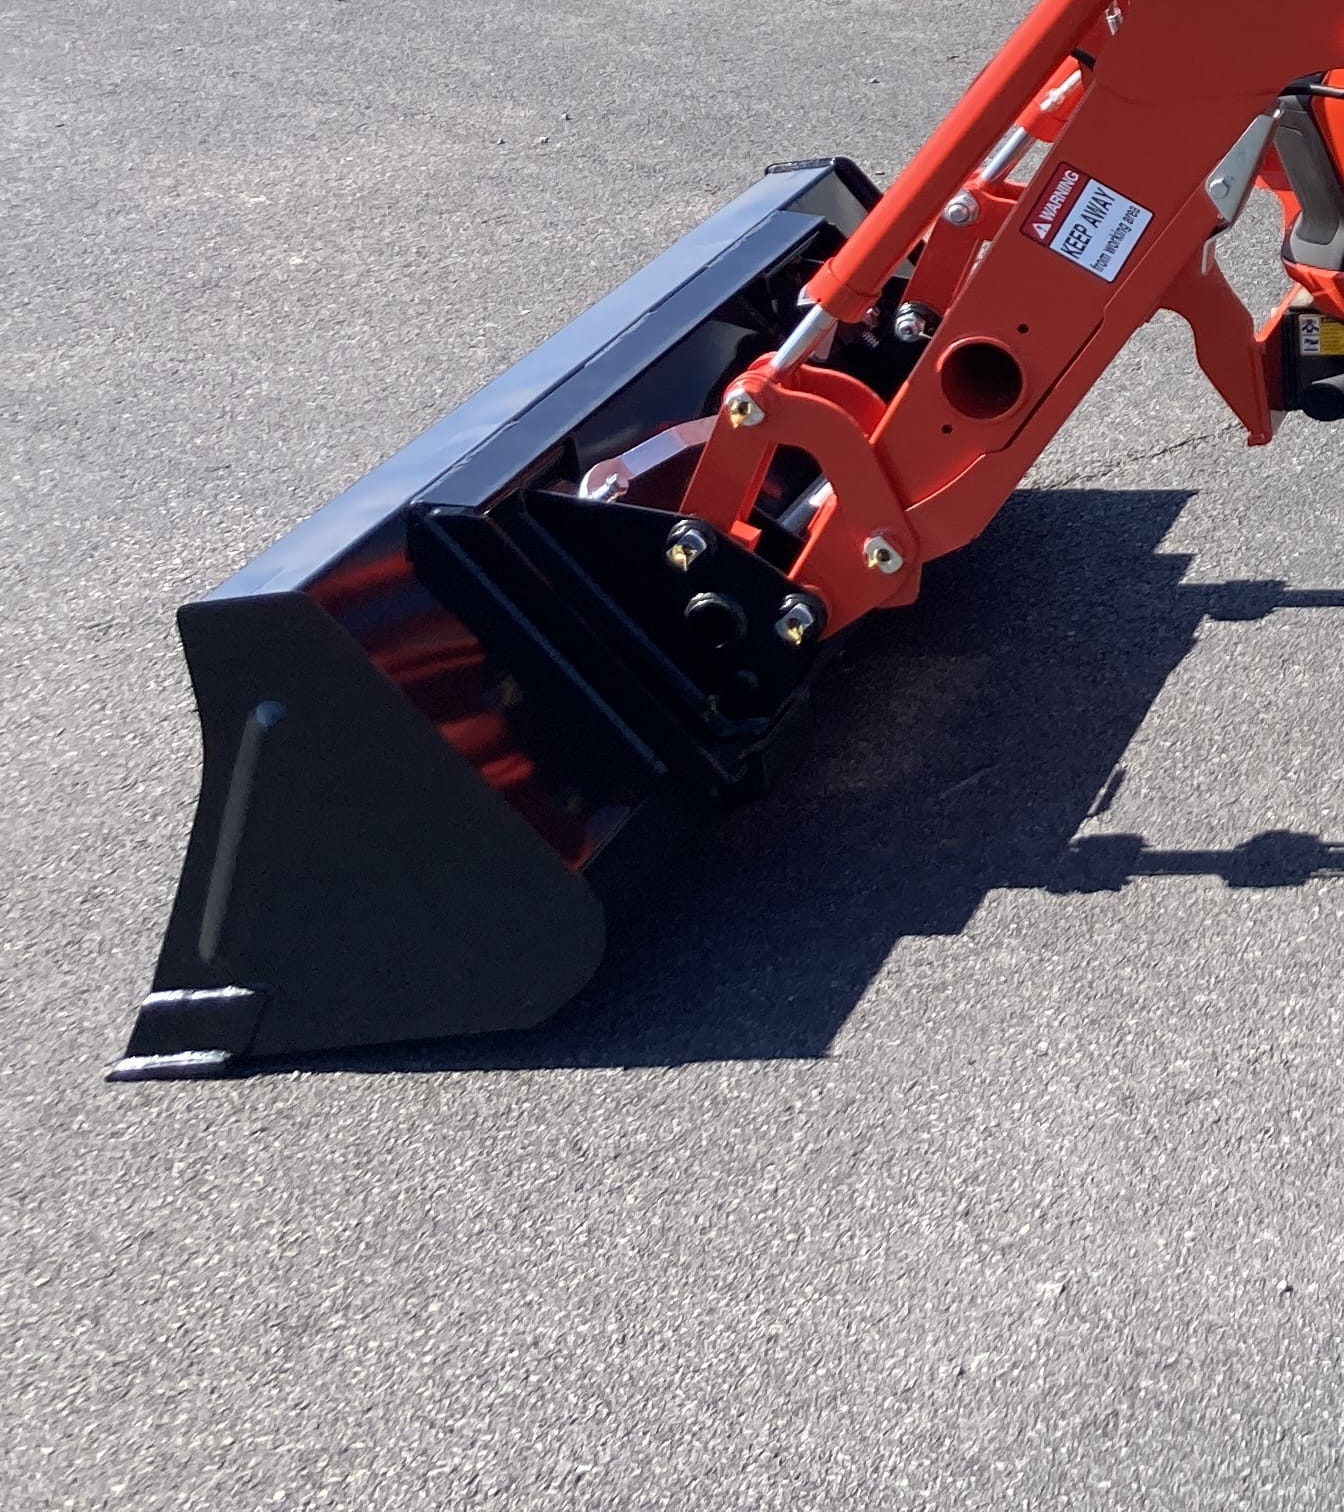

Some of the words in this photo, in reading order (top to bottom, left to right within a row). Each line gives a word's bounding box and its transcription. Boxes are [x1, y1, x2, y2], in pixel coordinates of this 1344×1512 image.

[1039, 169, 1080, 222] WARNING
[1060, 223, 1094, 260] KEEP
[1081, 186, 1116, 229] AWAY
[1089, 252, 1113, 273] from
[1103, 222, 1132, 255] working
[1122, 205, 1141, 226] area
